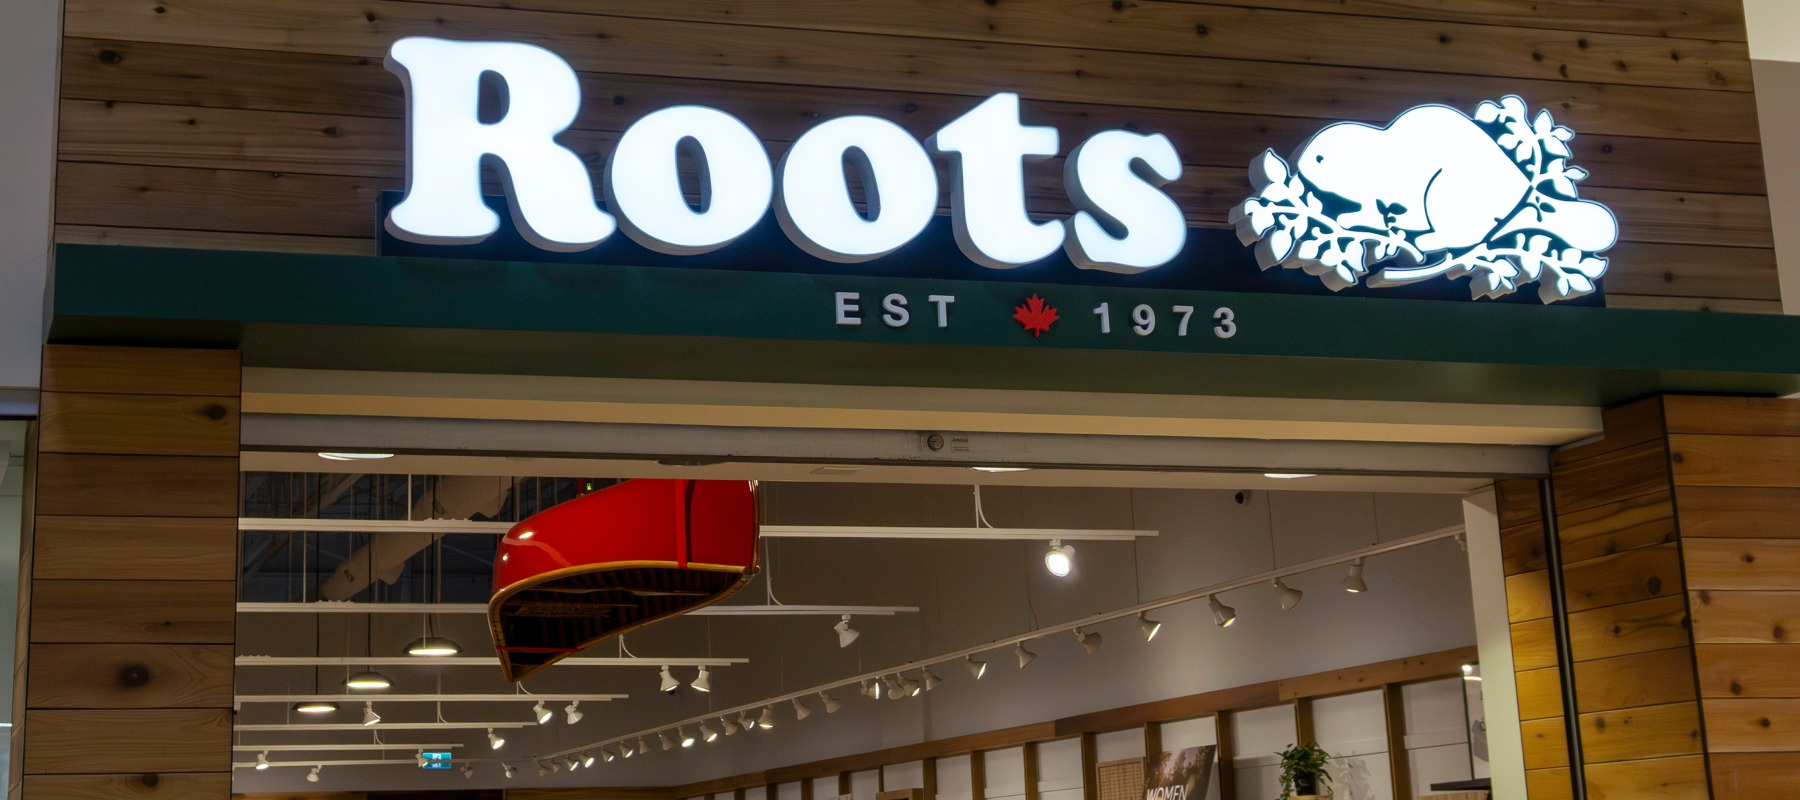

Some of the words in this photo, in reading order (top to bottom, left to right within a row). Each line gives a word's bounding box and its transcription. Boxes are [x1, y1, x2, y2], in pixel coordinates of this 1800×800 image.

[386, 35, 1186, 270] Roots
[835, 291, 955, 327] EST
[1093, 302, 1237, 339] 1973
[1146, 784, 1189, 800] WOMEN
